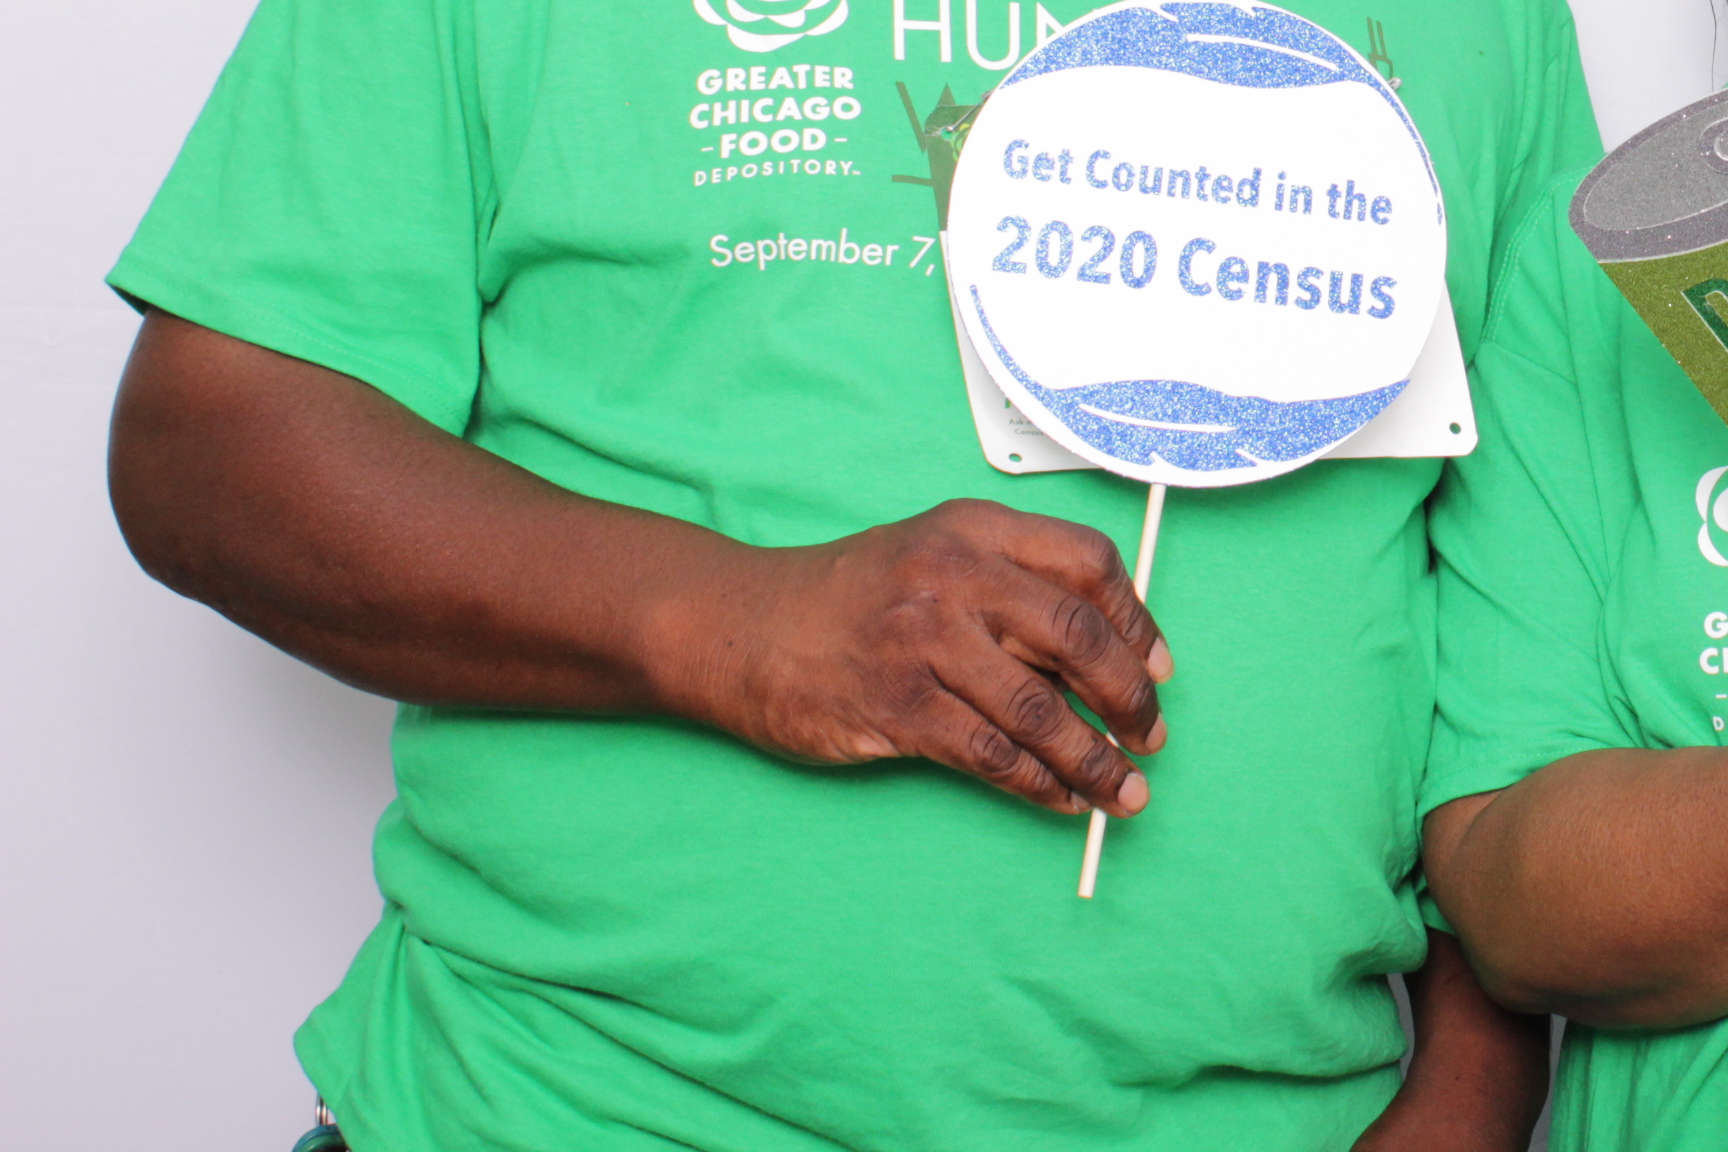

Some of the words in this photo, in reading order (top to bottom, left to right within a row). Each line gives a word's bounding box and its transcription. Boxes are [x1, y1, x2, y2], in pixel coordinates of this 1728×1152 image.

[696, 64, 855, 95] GREATER
[689, 96, 862, 129] CHICAGO
[1003, 139, 1074, 184] Get
[1085, 149, 1262, 208] Counted
[1274, 171, 1313, 215] in
[1326, 180, 1392, 226] the
[709, 228, 899, 271] September
[992, 215, 1158, 289] 2020
[1177, 237, 1398, 319] Census
